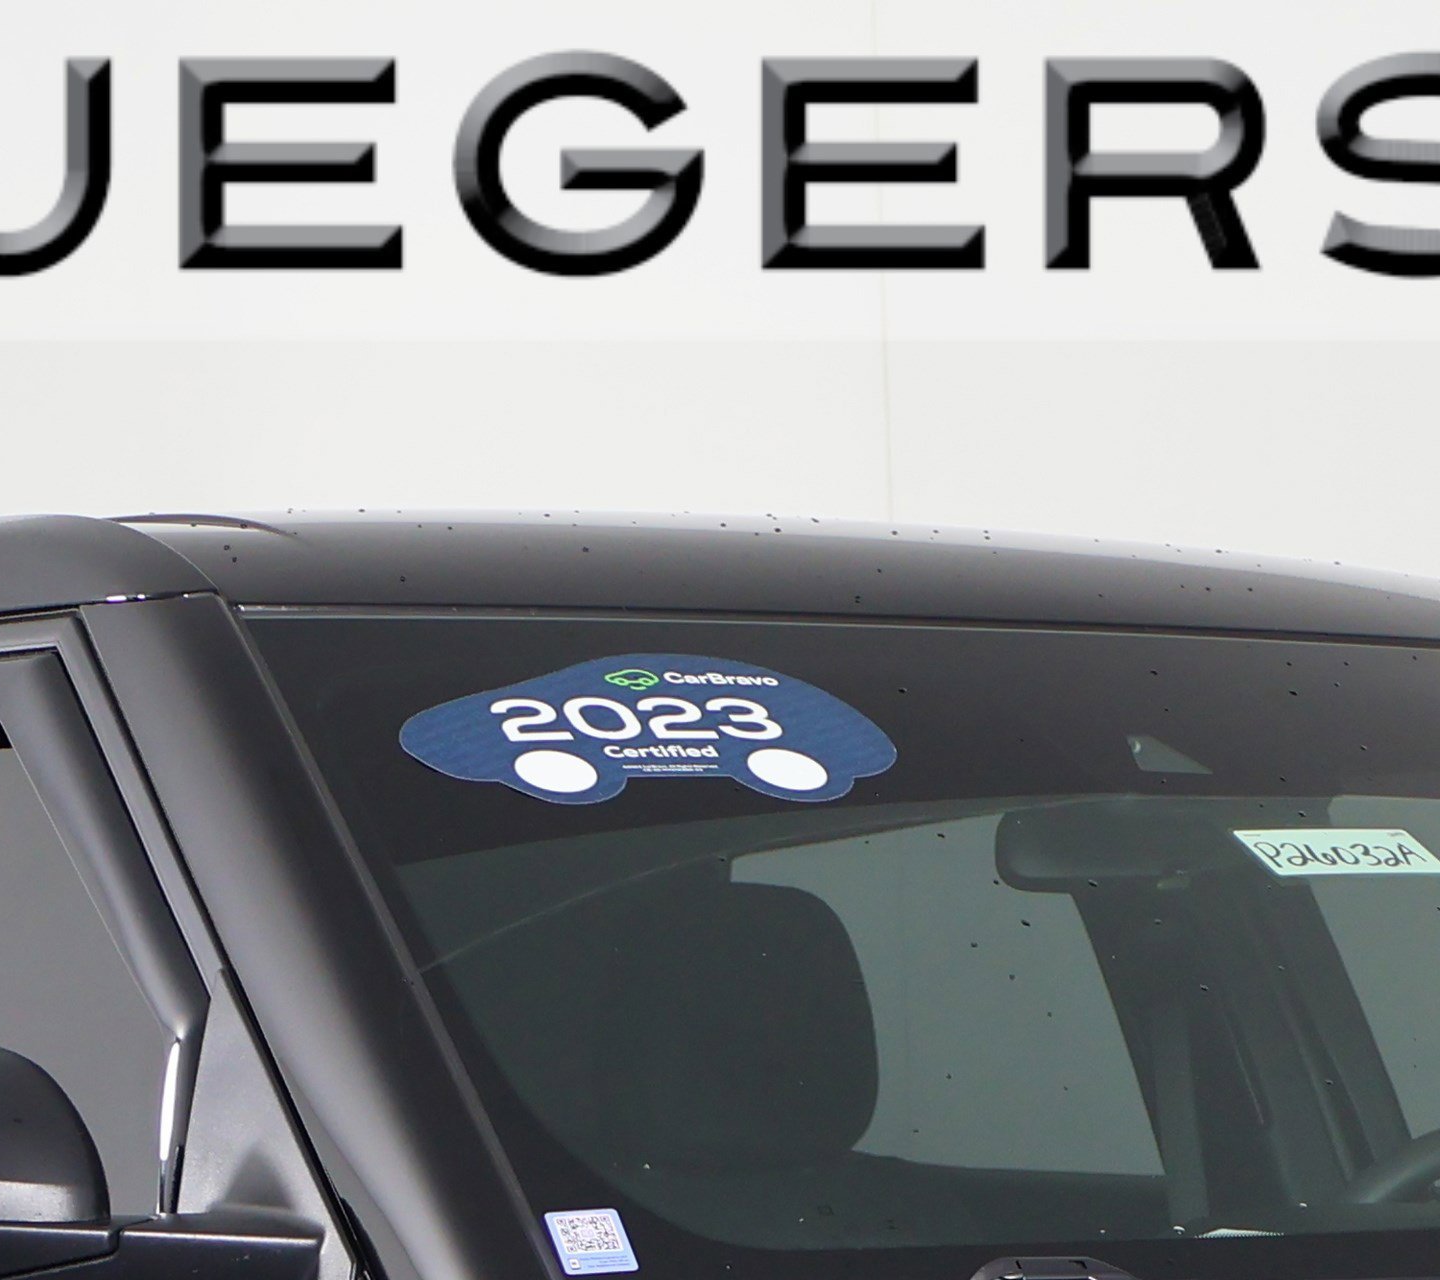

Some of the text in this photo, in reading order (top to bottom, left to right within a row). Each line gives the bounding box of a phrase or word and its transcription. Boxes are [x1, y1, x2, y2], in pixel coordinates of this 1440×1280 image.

[664, 669, 778, 688] CarBravo
[490, 696, 783, 742] 2023
[604, 745, 719, 760] Certified
[1253, 841, 1427, 869] P26032A
